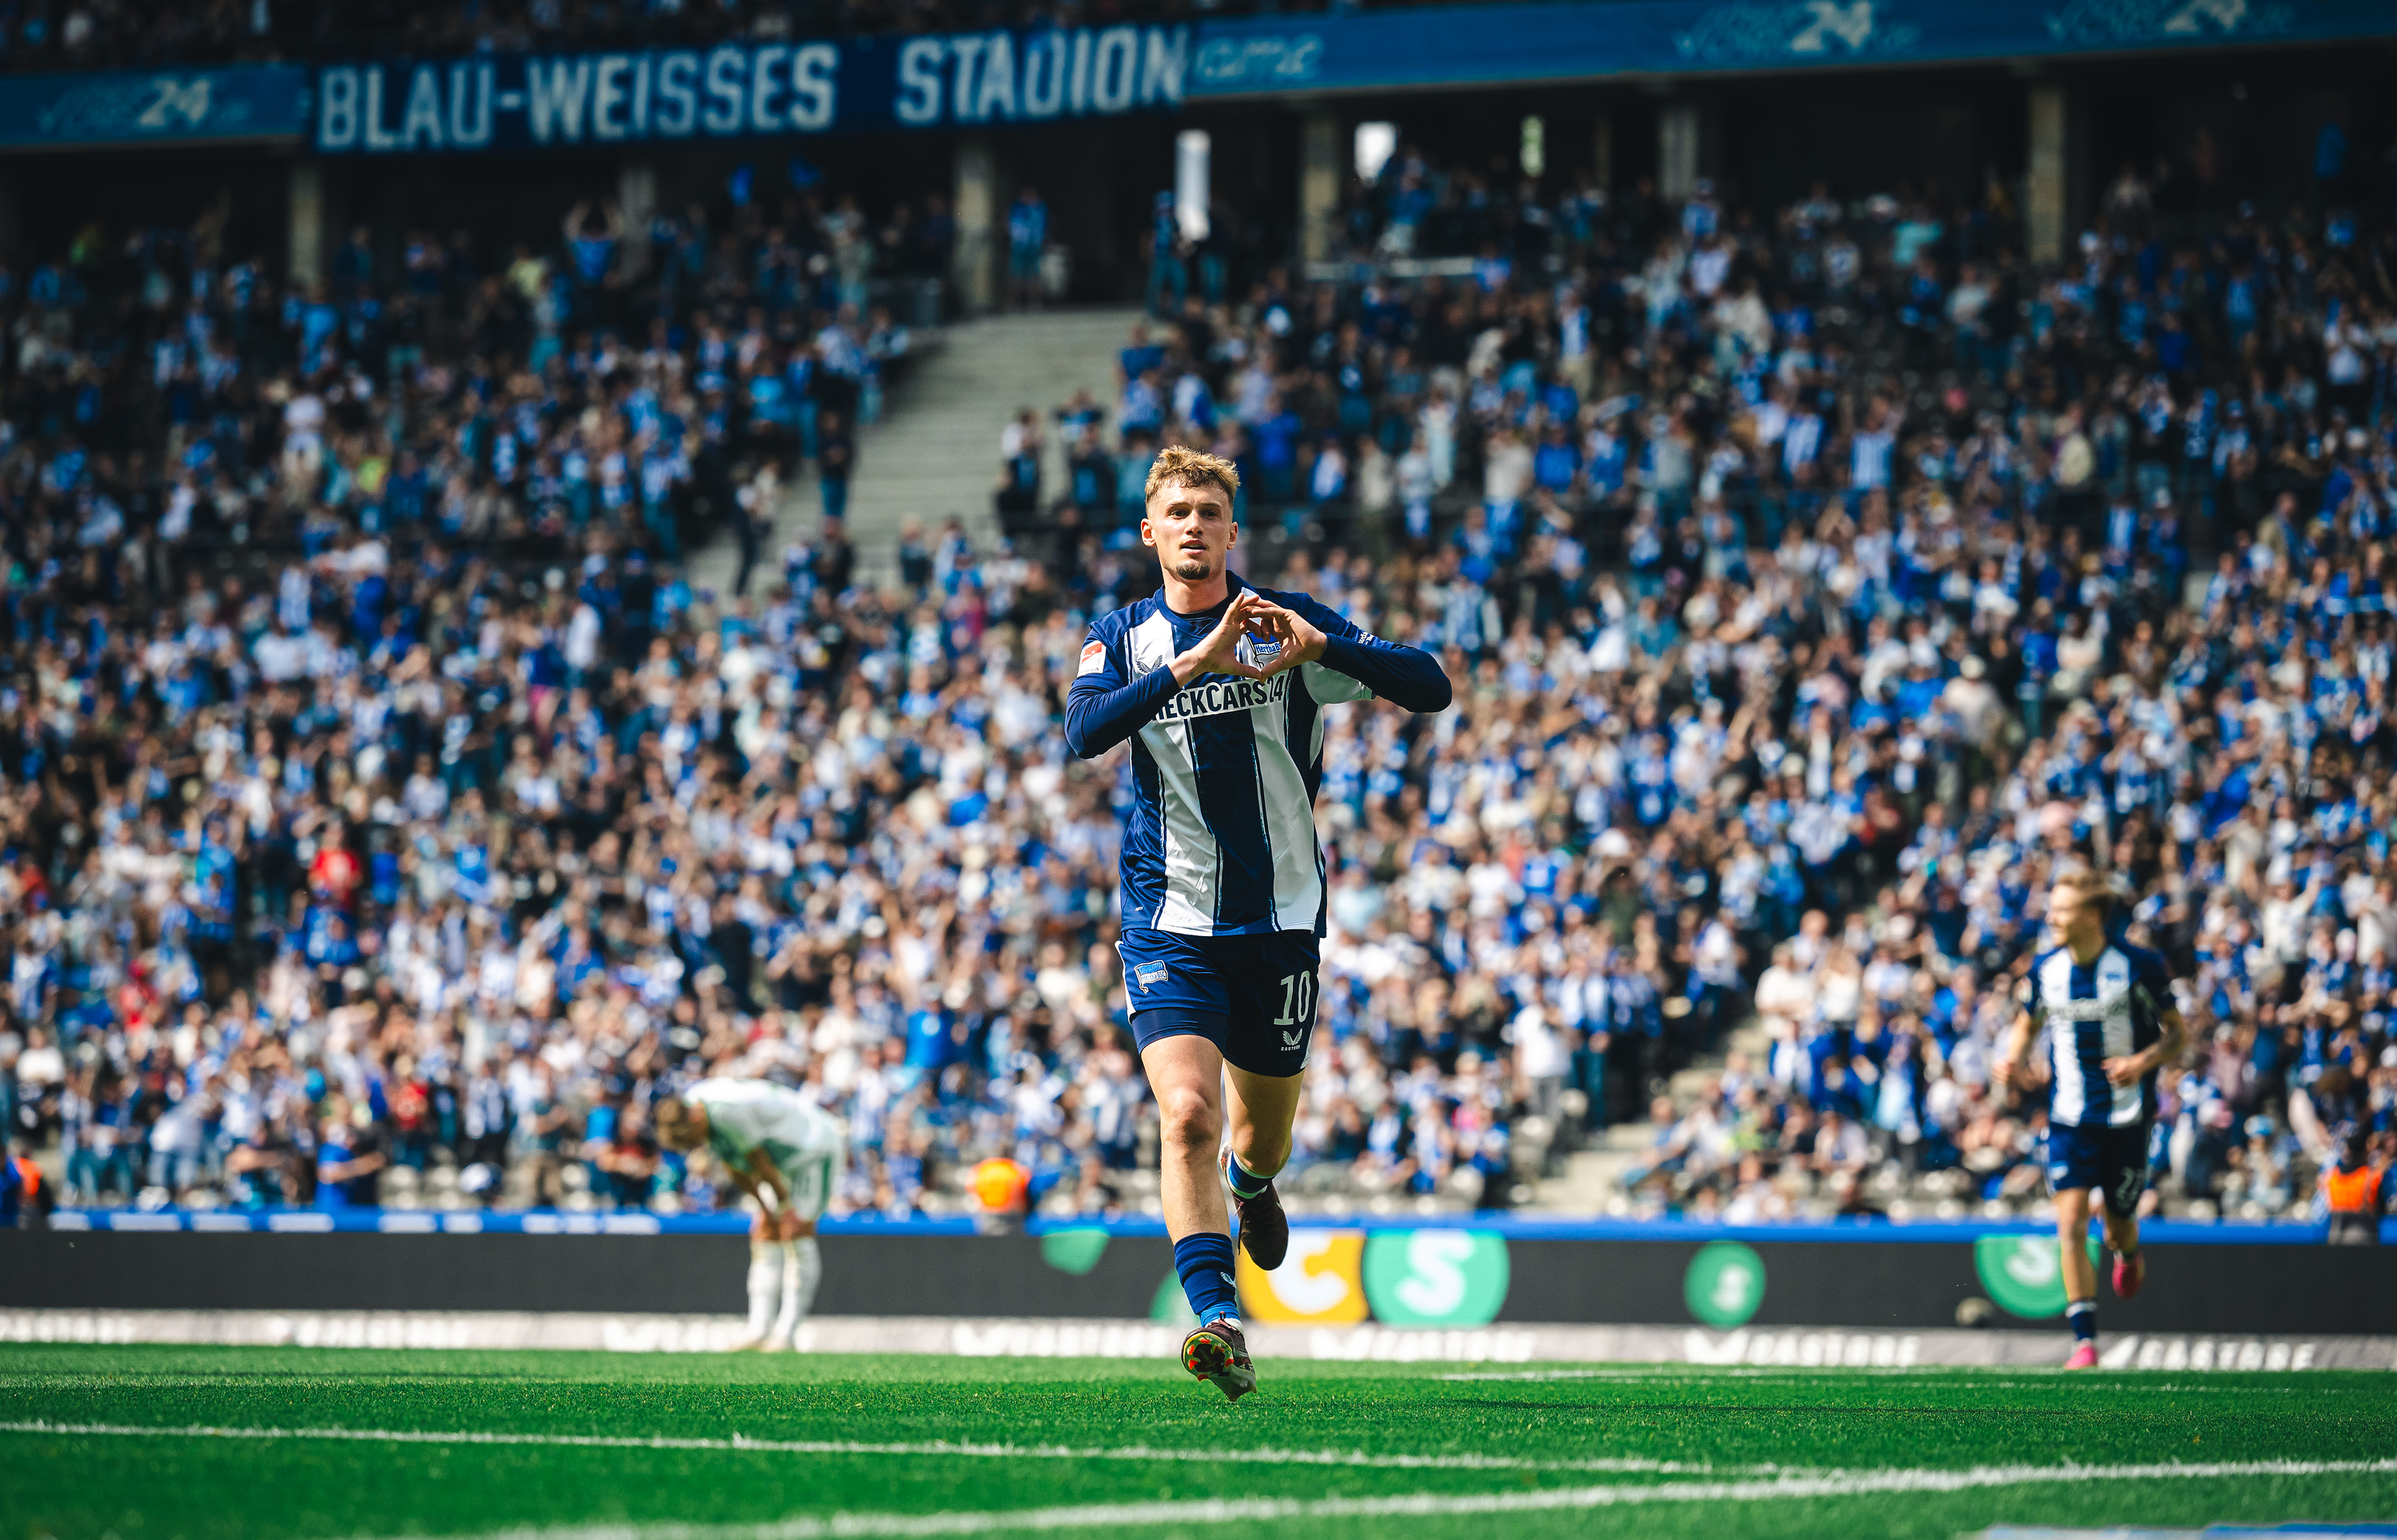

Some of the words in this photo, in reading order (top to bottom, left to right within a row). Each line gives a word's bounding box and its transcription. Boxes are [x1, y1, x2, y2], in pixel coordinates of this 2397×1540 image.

[321, 42, 837, 146] BLAU-WEISSES
[896, 26, 1189, 126] STADION
[1255, 644, 1276, 653] Hertha
[1274, 970, 1311, 1026] 10
